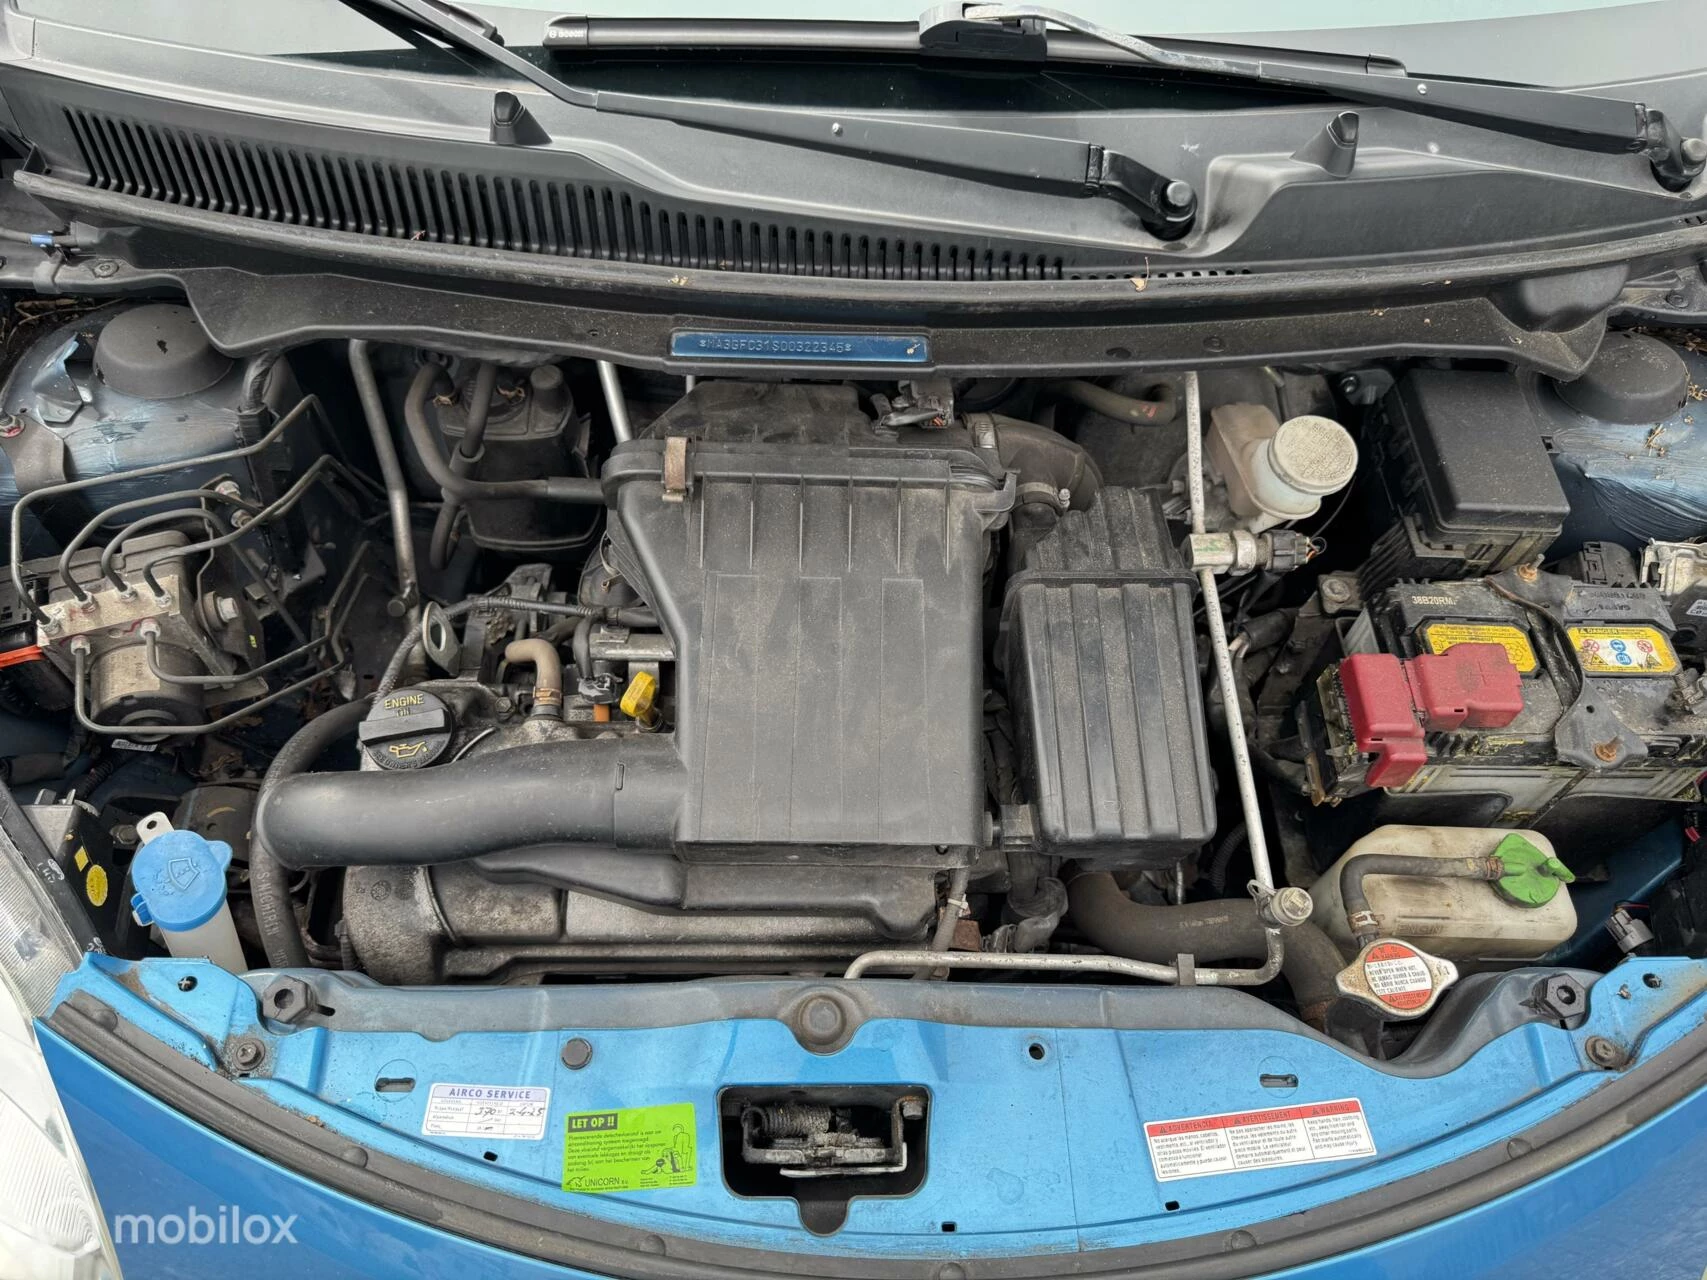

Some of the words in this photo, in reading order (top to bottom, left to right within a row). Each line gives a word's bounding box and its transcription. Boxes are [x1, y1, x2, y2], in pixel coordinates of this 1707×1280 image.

[384, 694, 425, 709] ENGINE
[449, 1088, 483, 1098] AIRCO
[486, 1089, 531, 1099] SERVICE
[1321, 1104, 1350, 1114] WARNING
[572, 1118, 588, 1129] LET
[590, 1117, 604, 1128] OP
[607, 1116, 615, 1126] !!
[1242, 1111, 1291, 1123] AVERTISSEMENT
[585, 1177, 620, 1187] UNICORN
